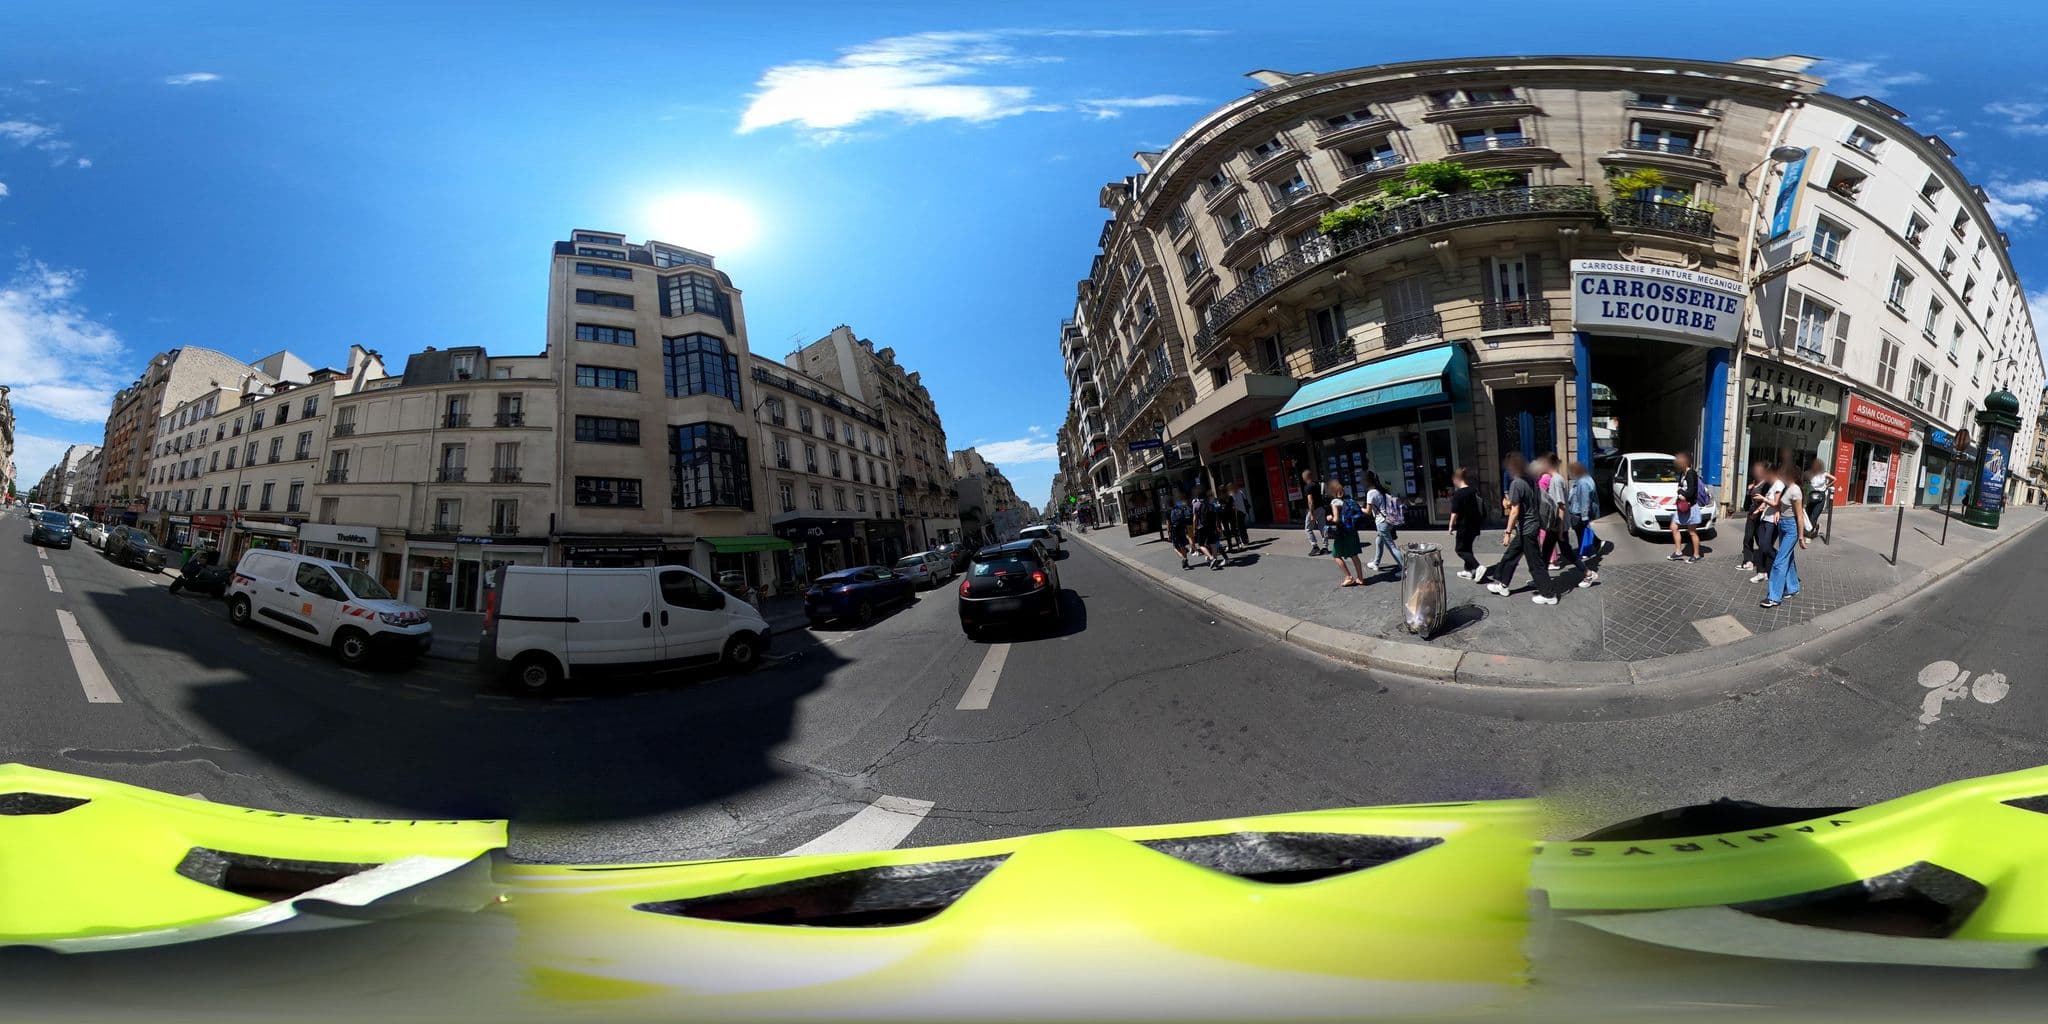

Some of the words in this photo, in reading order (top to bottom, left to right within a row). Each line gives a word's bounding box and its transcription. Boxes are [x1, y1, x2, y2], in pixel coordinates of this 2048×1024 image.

[1581, 262, 1645, 273] CARROSSERIE
[1651, 267, 1692, 281] PEINTURE
[1581, 278, 1738, 314] CARROSSERIE
[1602, 301, 1717, 331] LECOURBE
[1752, 366, 1824, 395] ATELIER
[1751, 385, 1796, 408] JEAN
[1747, 409, 1816, 432] LAUNAY
[1856, 404, 1876, 419] ASIAN
[1876, 409, 1906, 429] COCOONING
